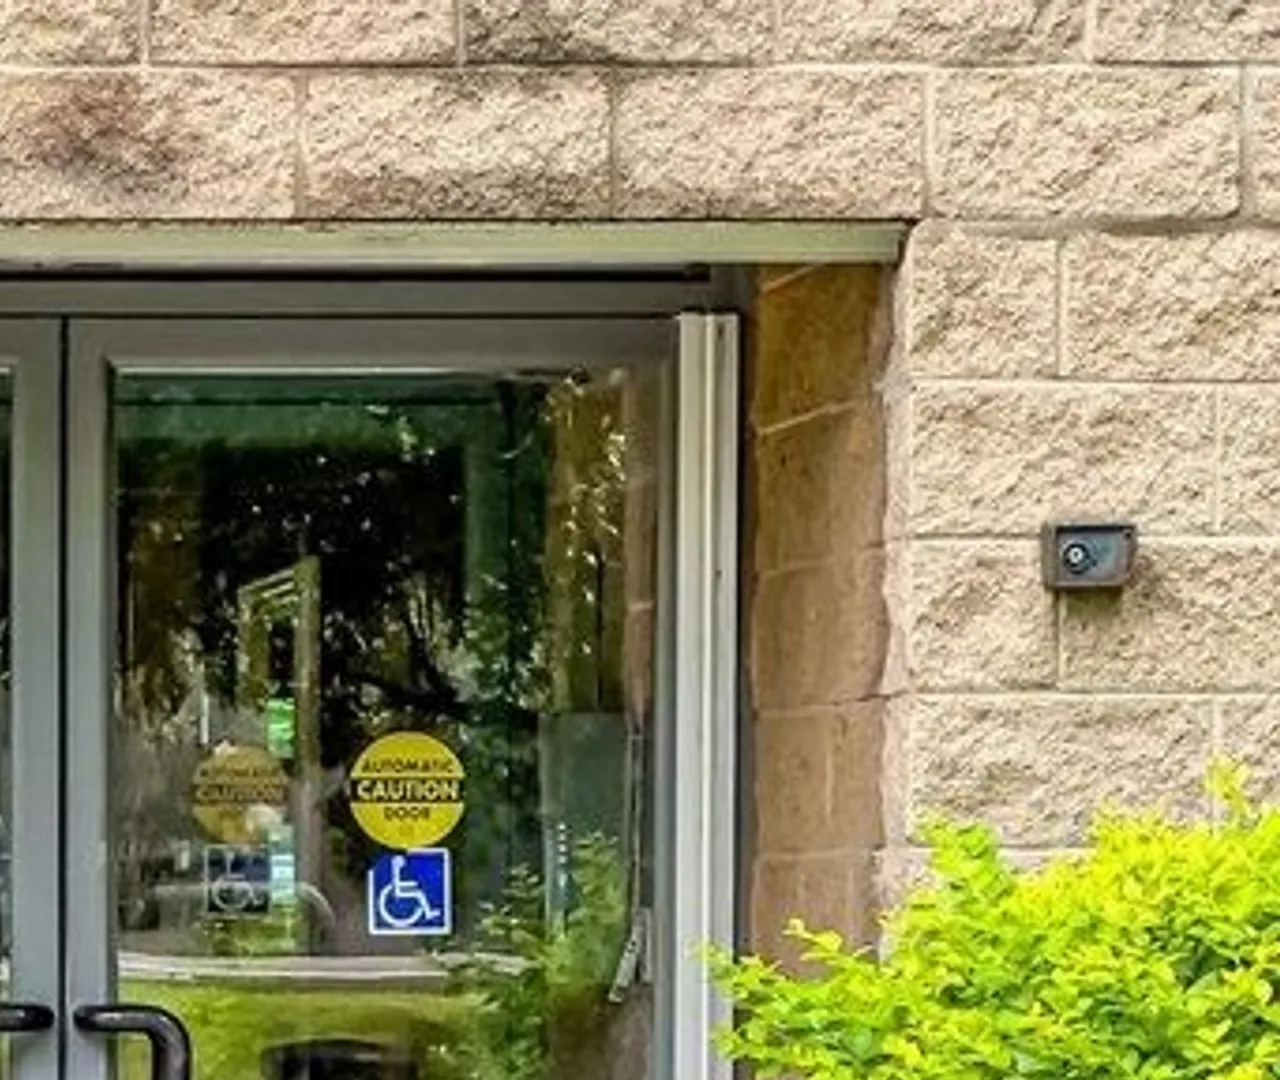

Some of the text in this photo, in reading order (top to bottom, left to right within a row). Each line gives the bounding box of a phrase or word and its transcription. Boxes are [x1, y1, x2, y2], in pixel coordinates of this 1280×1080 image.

[361, 757, 454, 773] AUTOMATIC
[357, 780, 459, 800] CAUTION
[384, 807, 430, 821] DOOR
